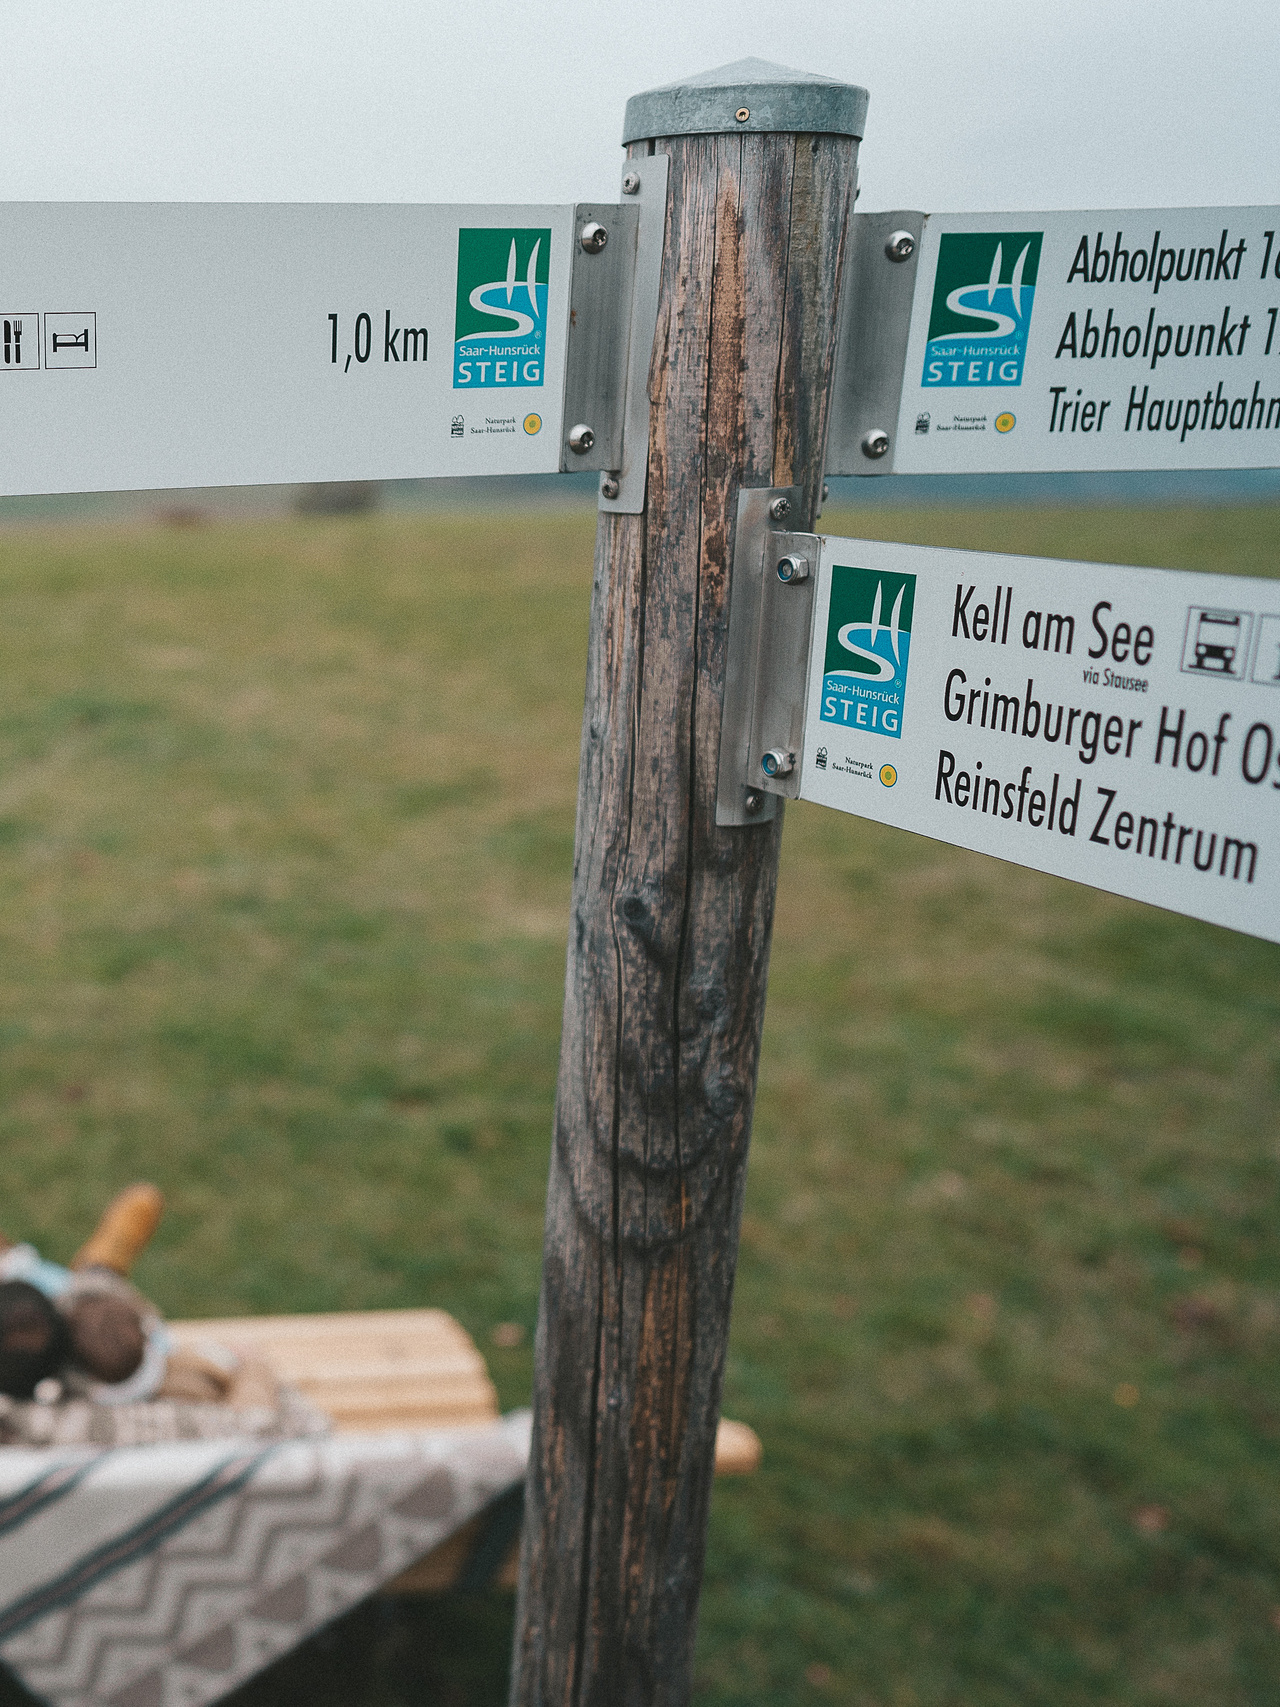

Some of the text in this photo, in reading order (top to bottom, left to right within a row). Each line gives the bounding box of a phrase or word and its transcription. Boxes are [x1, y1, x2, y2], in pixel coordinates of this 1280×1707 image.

[1066, 229, 1280, 294] Abholpunkt 1
[327, 310, 429, 374] 1,0 km
[458, 344, 541, 357] Saar-Hunsrück
[931, 344, 1021, 356] Saar-Hunsrück
[1055, 306, 1252, 370] Abholpunkt
[457, 360, 540, 383] STEIG
[927, 361, 1018, 382] STEIG
[485, 416, 517, 426] Naturpark
[1048, 385, 1112, 433] Trier
[951, 584, 1155, 666] Kell am See
[826, 680, 900, 705] Saar-Hunsrück
[1082, 665, 1149, 693] via Stausee
[824, 696, 898, 732] STEIG
[943, 668, 1143, 764] Grimburger
[1154, 705, 1231, 777] Hof
[845, 756, 873, 770] Naturpark
[934, 749, 1258, 884] Reinsfeld Zentrum
